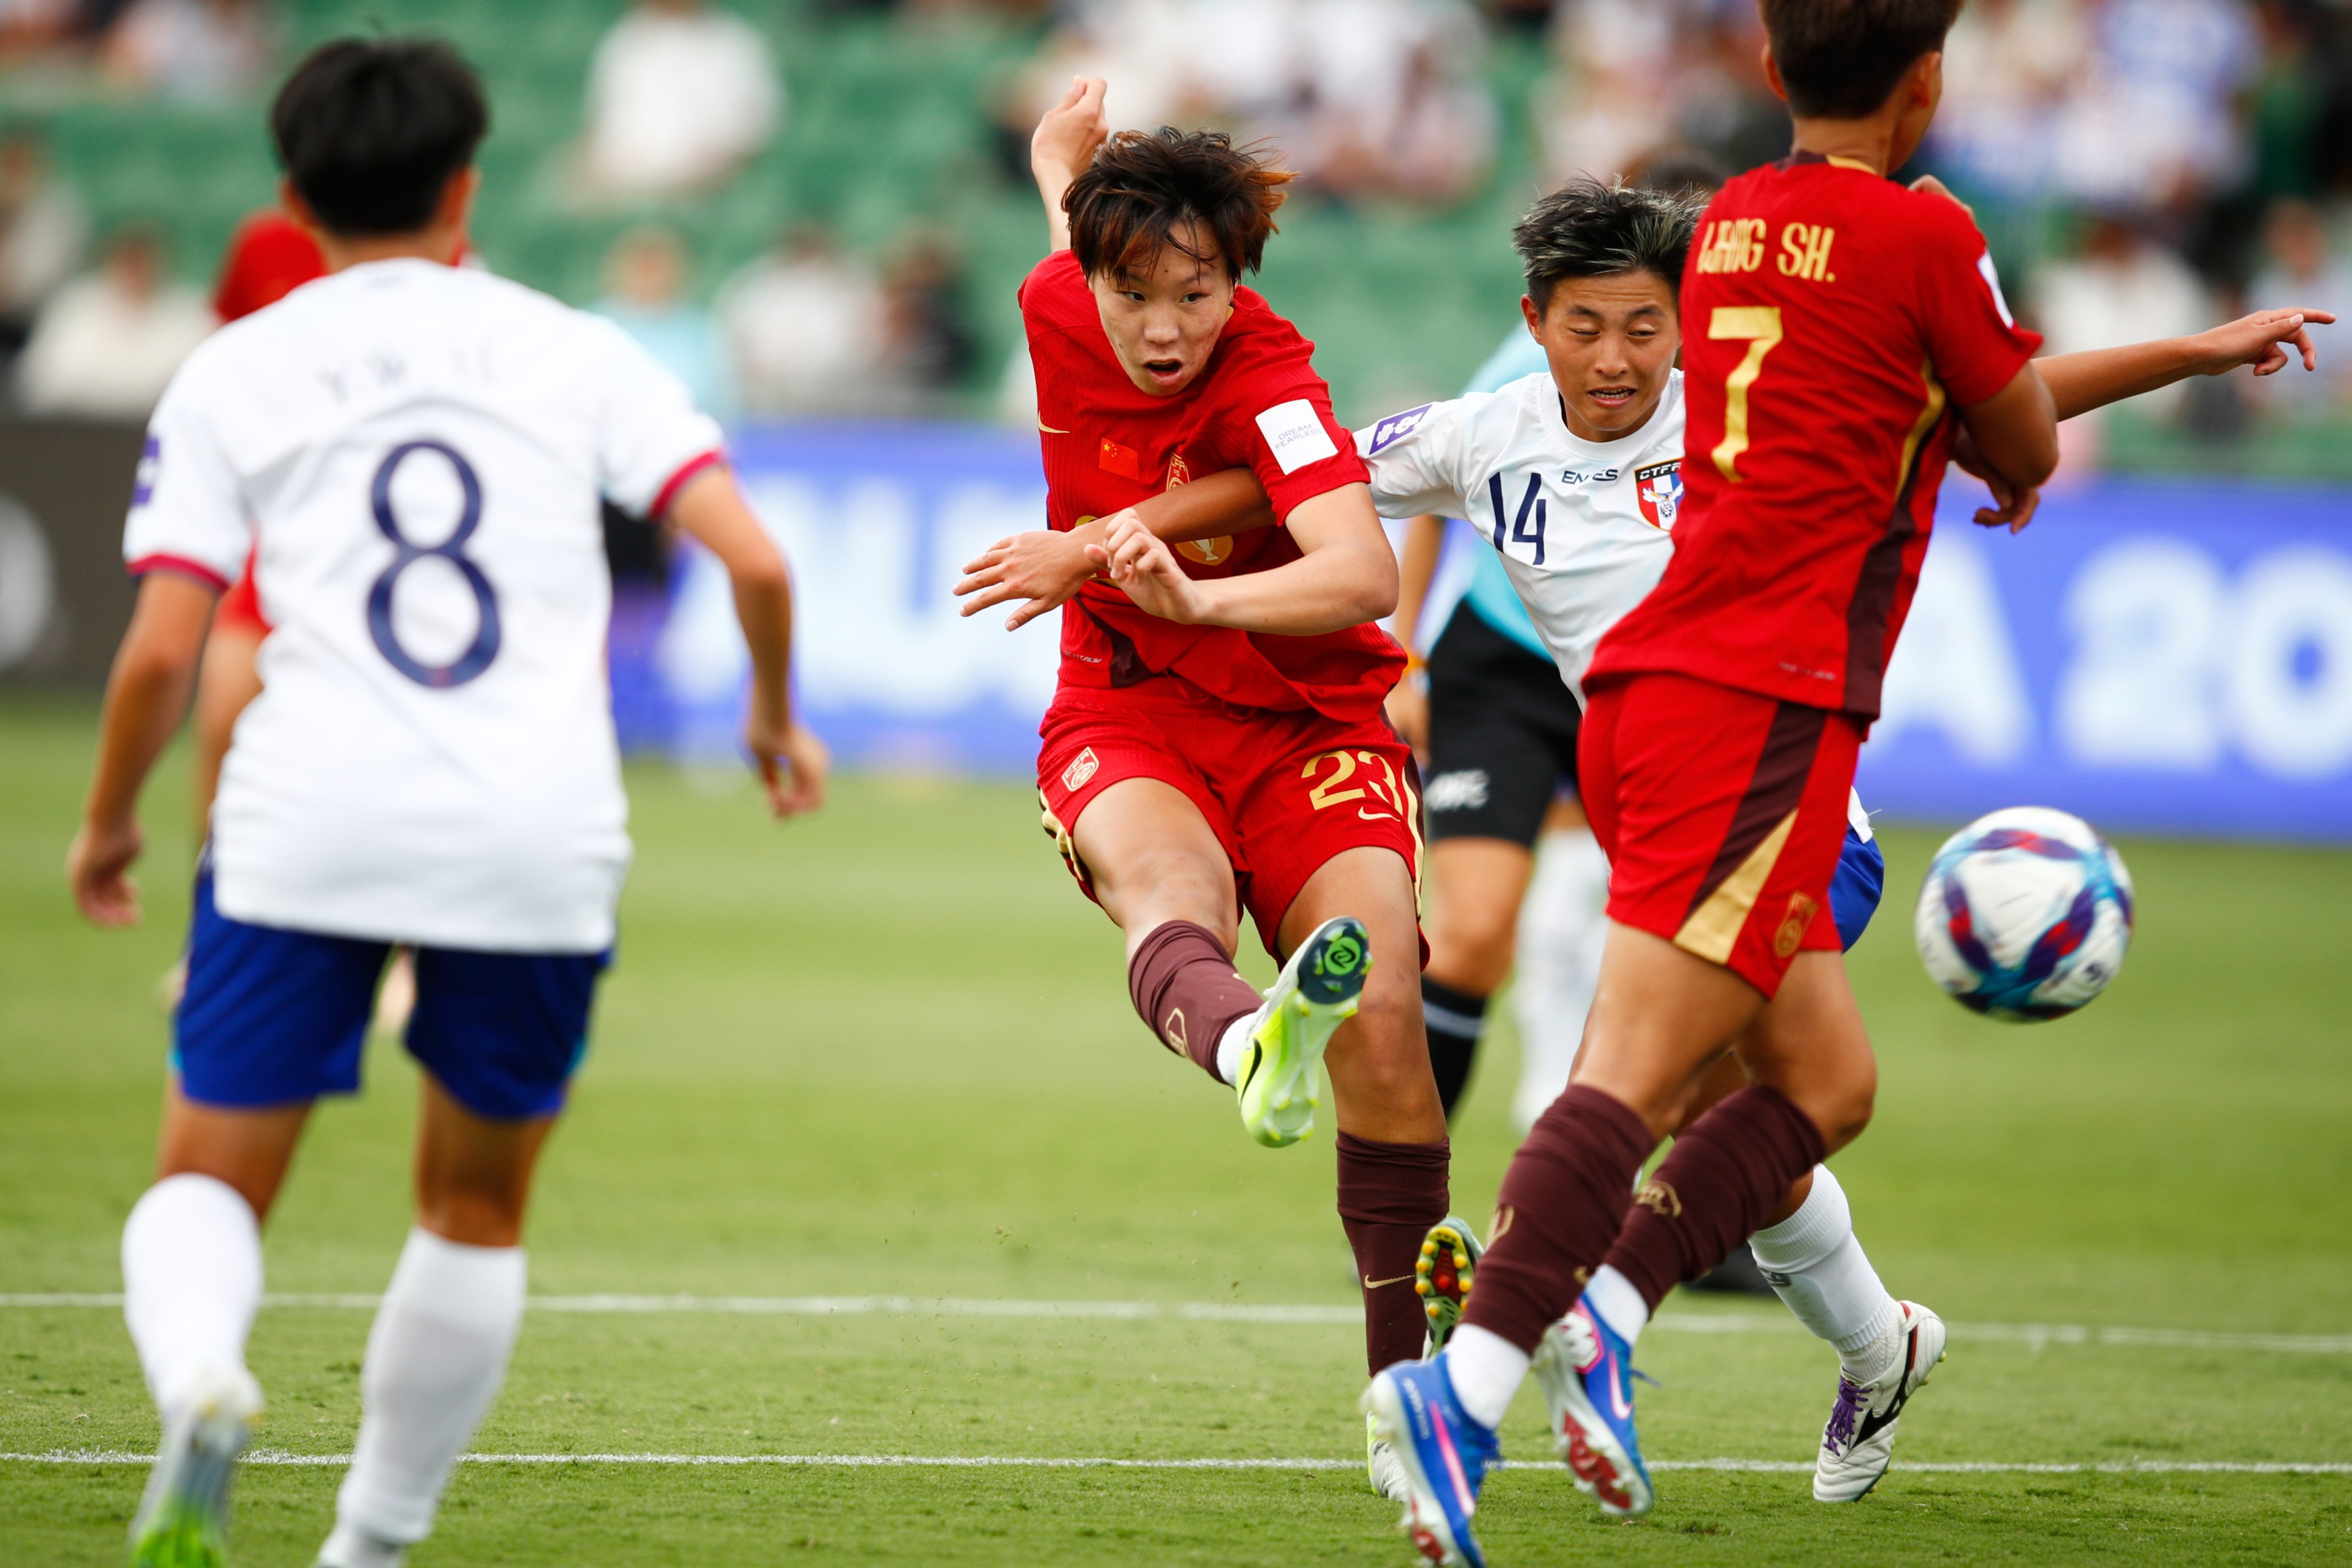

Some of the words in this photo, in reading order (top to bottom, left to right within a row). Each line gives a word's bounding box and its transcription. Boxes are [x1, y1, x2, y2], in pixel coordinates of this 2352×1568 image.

[1776, 221, 1836, 282] SH.
[1707, 306, 1783, 484] 7
[1275, 428, 1322, 450] FEARLESS
[1278, 424, 1313, 441] DREAM
[1489, 472, 1546, 565] 14
[366, 439, 501, 689] 8
[1300, 750, 1403, 816] 23
